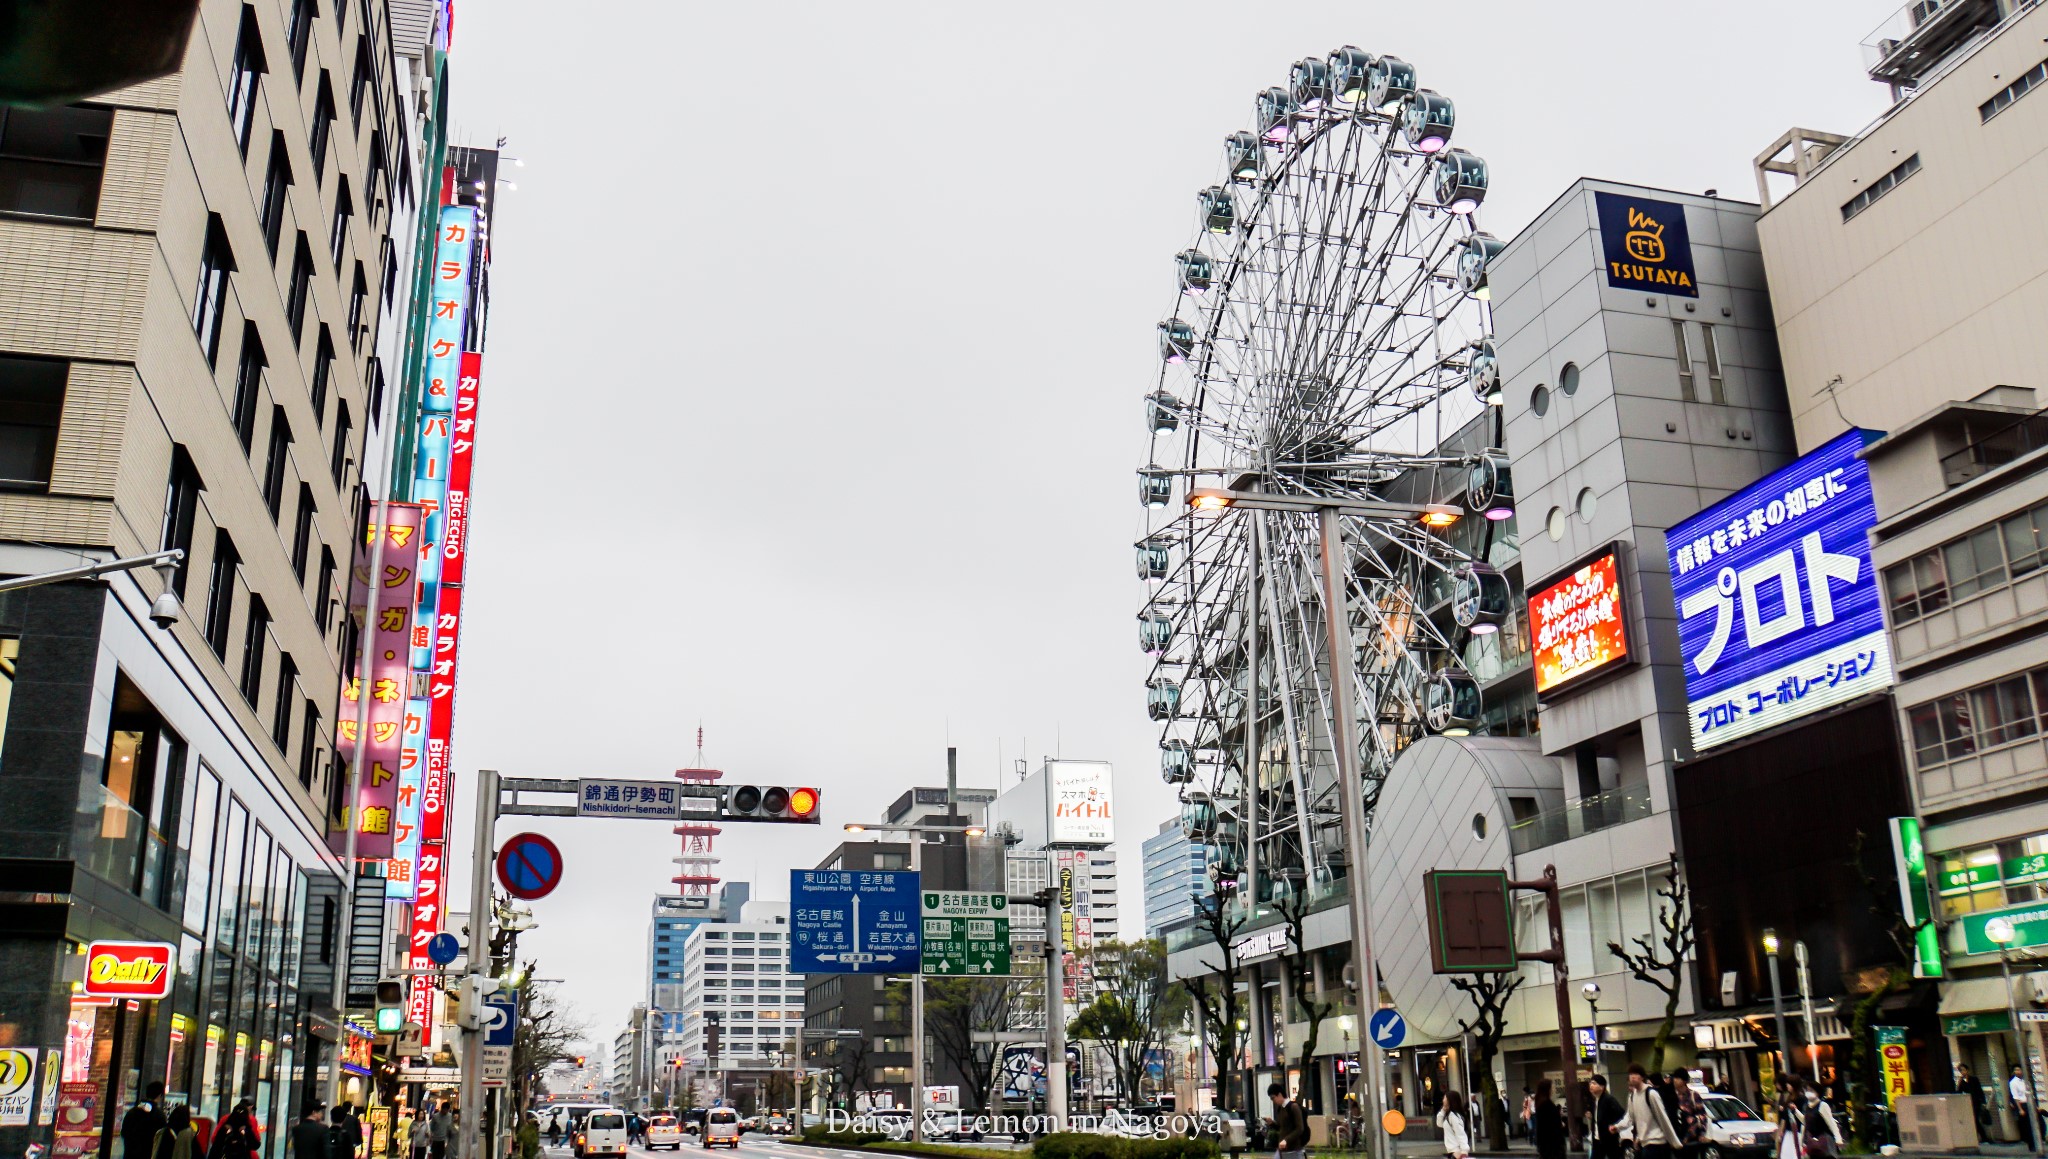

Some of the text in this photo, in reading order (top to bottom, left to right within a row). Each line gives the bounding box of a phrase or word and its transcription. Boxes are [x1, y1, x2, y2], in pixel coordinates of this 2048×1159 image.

[1611, 262, 1691, 287] TSUTAYA
[453, 376, 478, 454] カラオケ
[445, 490, 463, 559] BIG ECHO
[1677, 468, 1847, 574] 情報を未来の知恵に
[1681, 531, 1861, 676] プロト
[431, 613, 457, 699] カラオケ
[1698, 650, 1878, 734] プロト コーポレーション
[424, 738, 444, 813] BIG ECHO
[585, 783, 675, 804] 錦通伊勢町
[583, 802, 676, 815] Nishikidori-Isemachi
[1056, 801, 1112, 818] バイトル
[804, 872, 895, 885] 東山公園 空港線
[413, 854, 439, 948] カラオケ
[930, 896, 935, 906] 1
[942, 894, 989, 907] 名古屋高速
[995, 897, 1002, 906] R
[1076, 891, 1089, 904] DUTY
[796, 909, 844, 921] 名古屋城
[879, 910, 905, 921] 金山
[1077, 904, 1089, 917] FREE
[797, 921, 820, 929] Nagoya
[799, 932, 807, 941] 19
[816, 931, 844, 943] 桜通
[868, 931, 916, 944] 若宮大通
[867, 944, 918, 952] Wakamiya-odori
[971, 941, 1005, 952] 都心環状
[843, 954, 869, 962] 大津通
[92, 954, 167, 984] Daily
[0, 1096, 30, 1105] てパン
